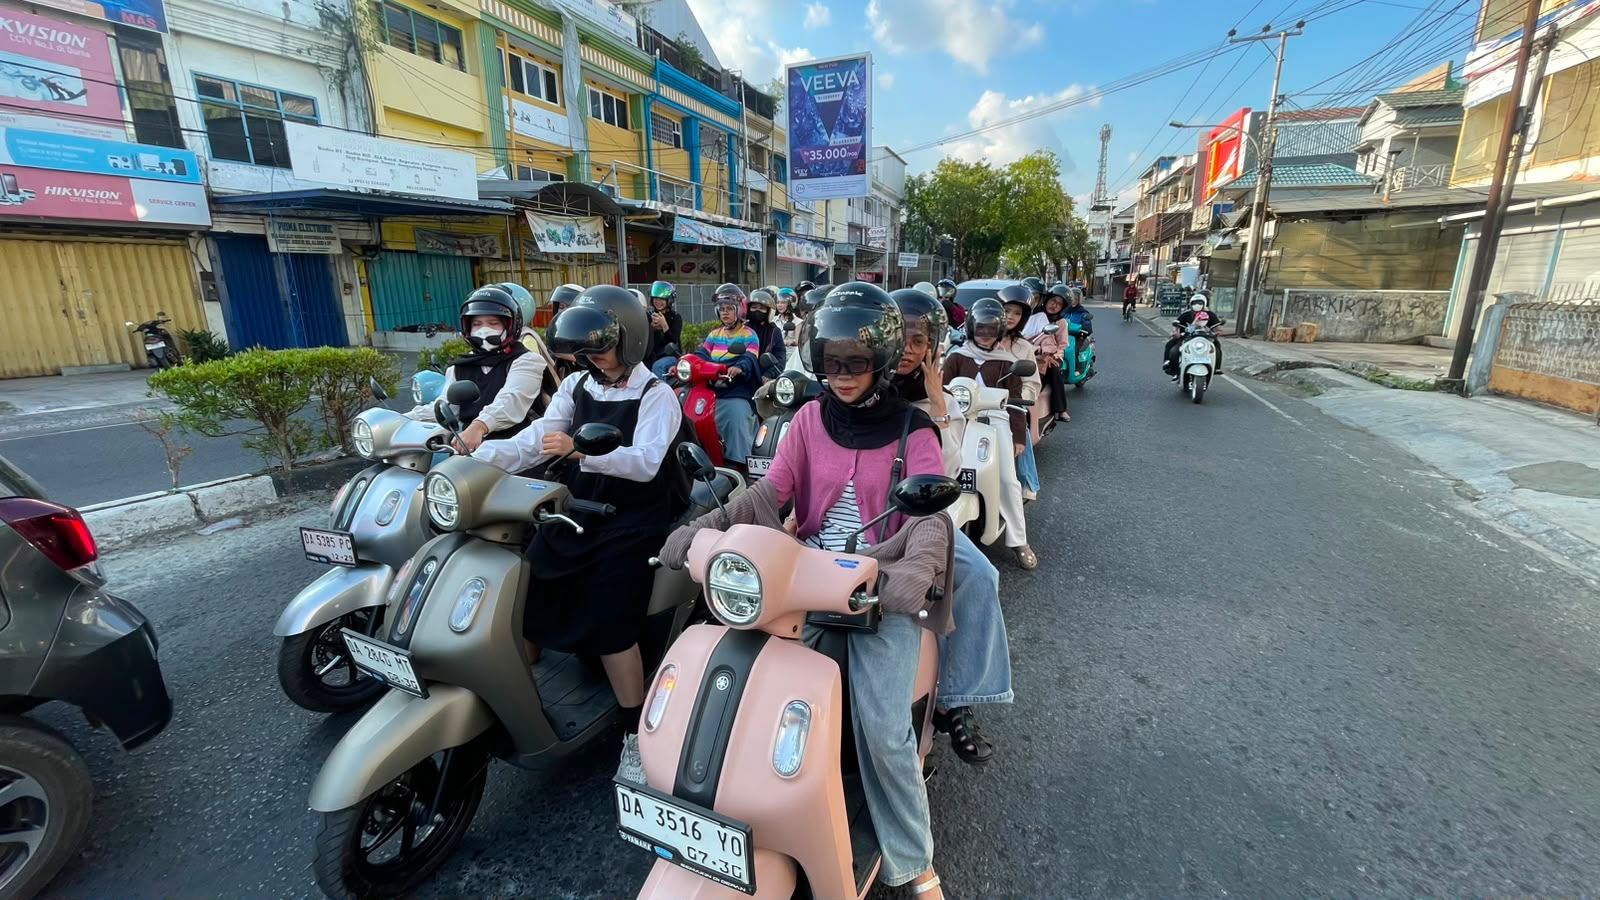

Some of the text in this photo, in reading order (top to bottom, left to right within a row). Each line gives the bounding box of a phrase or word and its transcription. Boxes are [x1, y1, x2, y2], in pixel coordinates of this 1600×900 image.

[121, 12, 157, 29] MAS
[9, 34, 32, 46] CCTV
[801, 70, 860, 93] VEEVA
[44, 186, 120, 200] HIKVISION
[149, 198, 196, 208] SERVICE CENTER
[1290, 294, 1355, 316] PARKIR
[748, 459, 758, 469] DA
[961, 472, 972, 481] AS
[304, 533, 315, 544] DA
[316, 534, 336, 549] 5385
[346, 638, 363, 656] DA
[621, 791, 742, 857] DA 3516 YO
